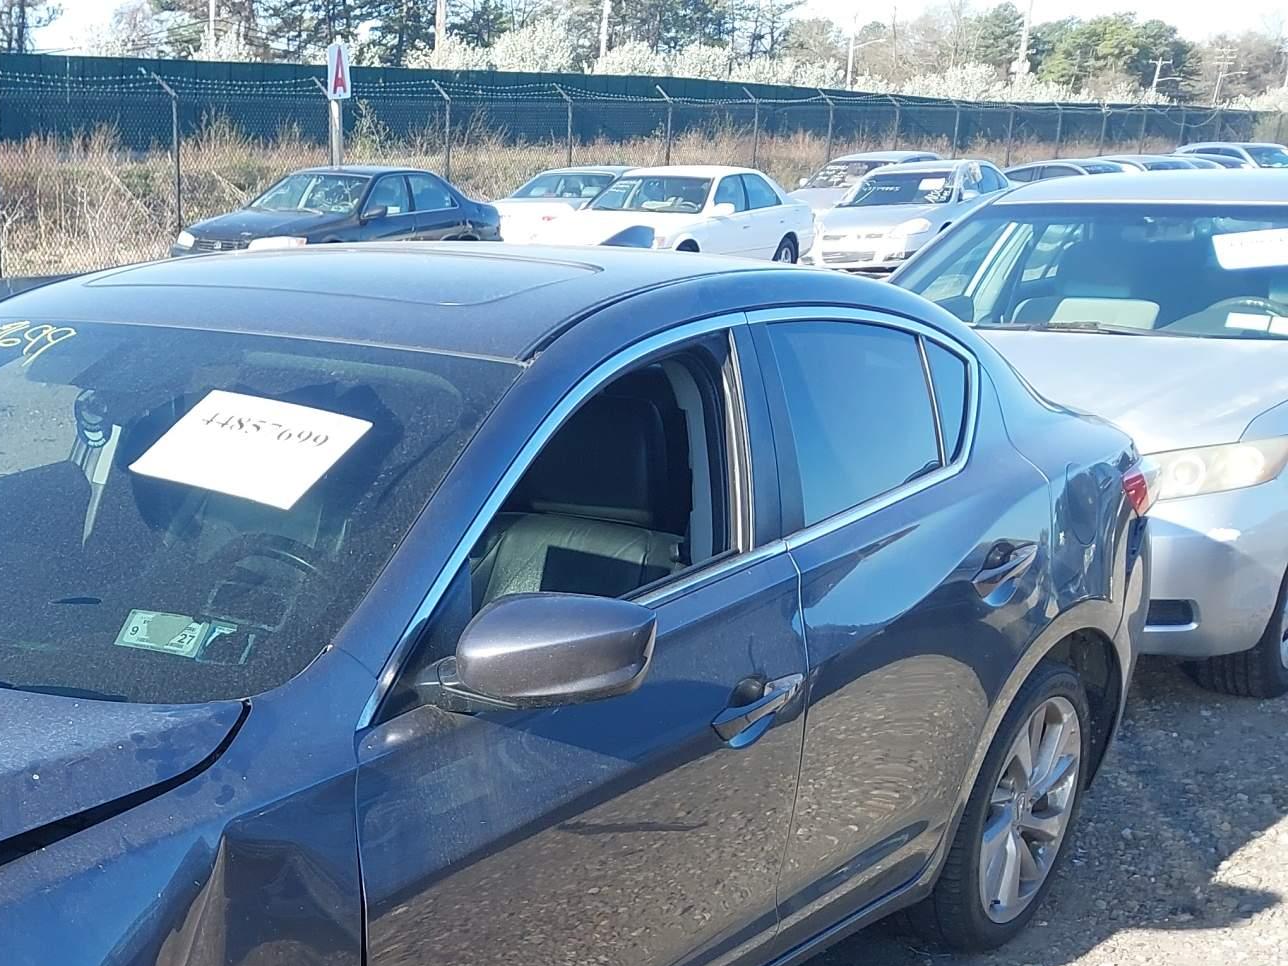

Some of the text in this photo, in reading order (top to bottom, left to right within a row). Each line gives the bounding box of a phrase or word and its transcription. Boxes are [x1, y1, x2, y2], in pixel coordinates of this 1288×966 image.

[334, 47, 347, 94] A
[129, 626, 195, 645] 9 27
